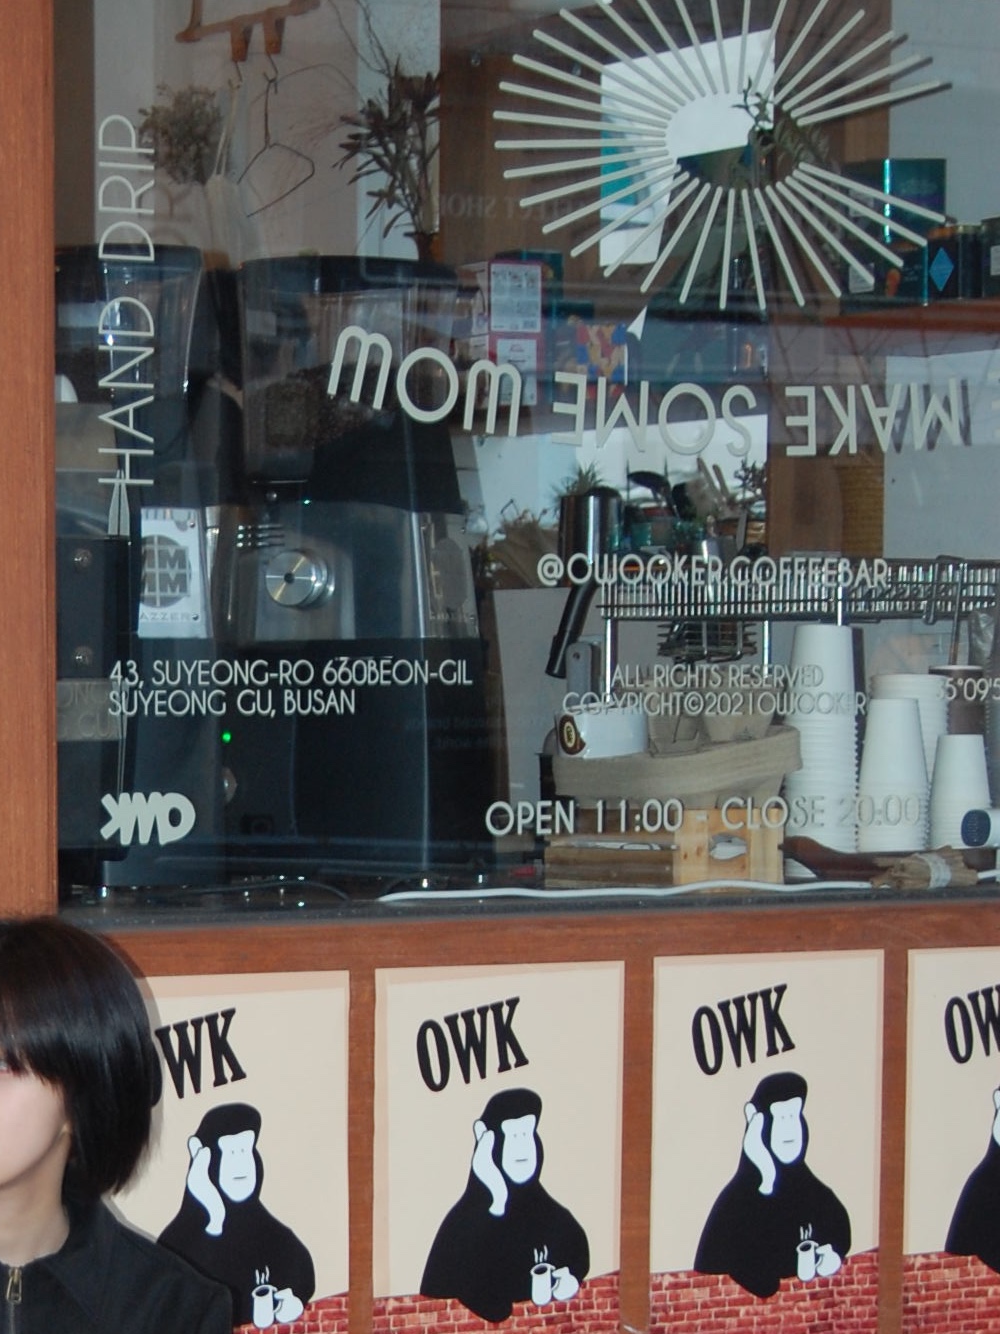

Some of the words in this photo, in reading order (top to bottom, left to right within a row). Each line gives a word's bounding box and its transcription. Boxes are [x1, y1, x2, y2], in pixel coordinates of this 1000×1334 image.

[98, 114, 155, 263] DRIP
[98, 296, 154, 485] HAND
[552, 371, 757, 457] SOME
[108, 689, 226, 717] SUYEONG
[236, 689, 276, 718] GU,
[284, 689, 356, 716] BUSAN
[109, 660, 144, 689] 43,
[152, 659, 314, 687] SUYEONG-RO
[611, 665, 647, 688] ALL
[653, 665, 722, 688] RIGHTS
[729, 664, 825, 688] RESERVED
[485, 800, 575, 836] OPEN
[595, 798, 684, 834] 11:00
[721, 796, 825, 831] CLOSE
[155, 1007, 247, 1100] WK
[416, 996, 530, 1093] OWK
[691, 983, 796, 1077] OWK
[945, 984, 1000, 1065] OW
